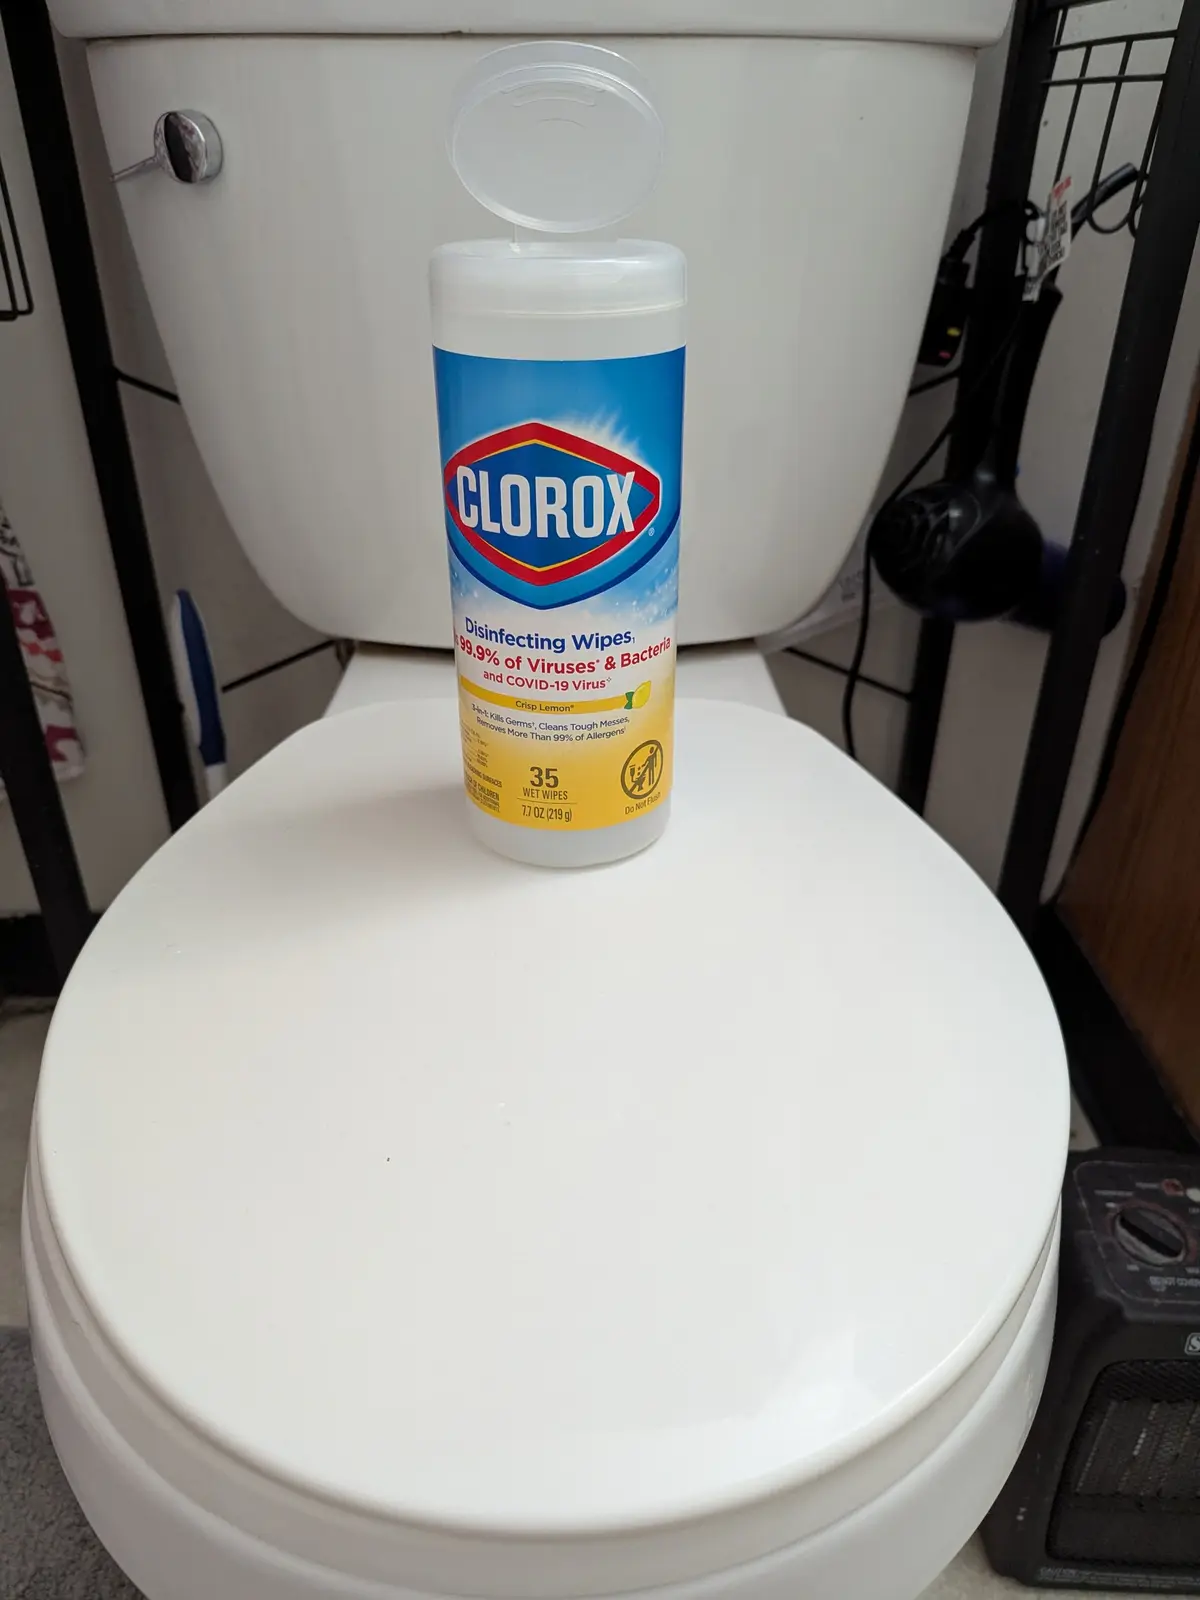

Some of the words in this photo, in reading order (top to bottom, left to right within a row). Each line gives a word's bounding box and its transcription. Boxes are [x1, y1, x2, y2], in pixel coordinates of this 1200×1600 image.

[456, 465, 635, 538] CLOROX
[465, 617, 565, 653] Disinfecting
[460, 637, 500, 666] 99.9%
[504, 656, 522, 671] of
[604, 656, 616, 670] &
[620, 637, 671, 667] Bacteria
[483, 670, 503, 684] and
[506, 675, 569, 691] COVID-19
[515, 700, 537, 711] Crisp
[476, 717, 506, 734] Removes
[507, 728, 528, 739] More
[529, 732, 552, 741] Than
[553, 734, 573, 742] 99%
[575, 733, 585, 741] of
[489, 712, 504, 723] Kills
[538, 722, 568, 731] Cleans
[570, 721, 599, 732] Tough
[600, 716, 630, 728] Messes,
[530, 766, 559, 788] 35
[522, 787, 540, 799] WET
[542, 790, 568, 801] WIPES
[521, 805, 532, 817] 7.7
[533, 806, 545, 819] OZ
[546, 808, 563, 822] (219
[564, 808, 573, 823] g)
[624, 805, 635, 815] Do
[635, 800, 646, 811] Not
